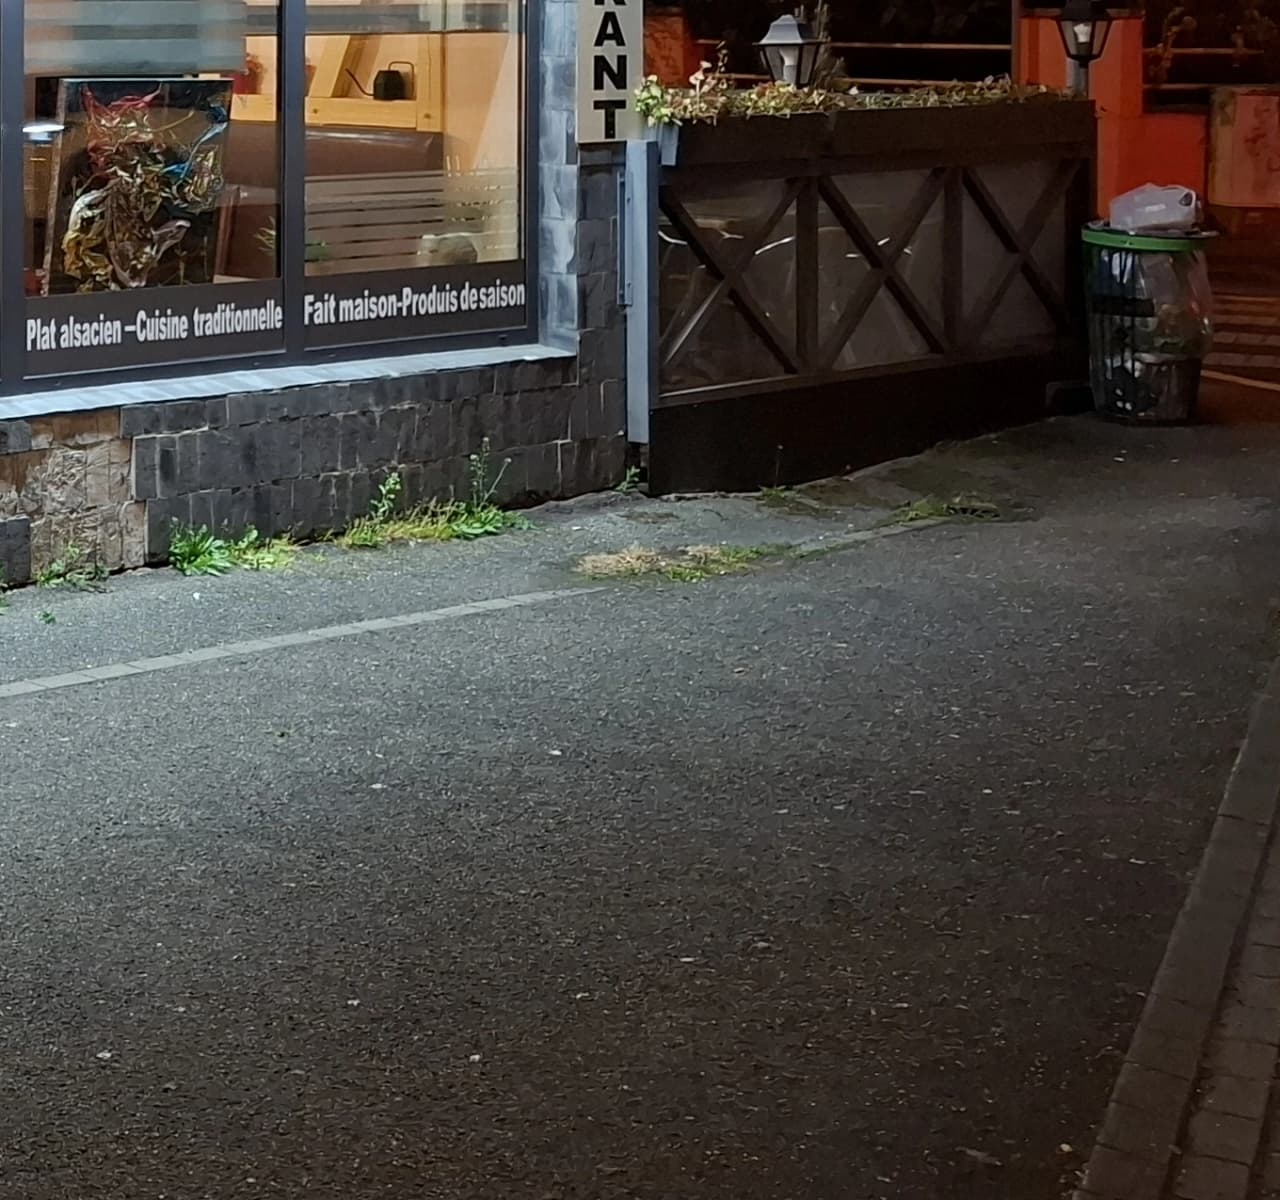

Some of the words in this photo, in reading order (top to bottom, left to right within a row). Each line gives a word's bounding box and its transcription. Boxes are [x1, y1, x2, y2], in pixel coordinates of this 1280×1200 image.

[26, 318, 57, 351] Plat
[59, 313, 122, 349] alsacien
[193, 299, 282, 337] traditionnelle
[304, 293, 336, 325] Fait
[460, 281, 477, 311] de
[479, 279, 525, 310] saison
